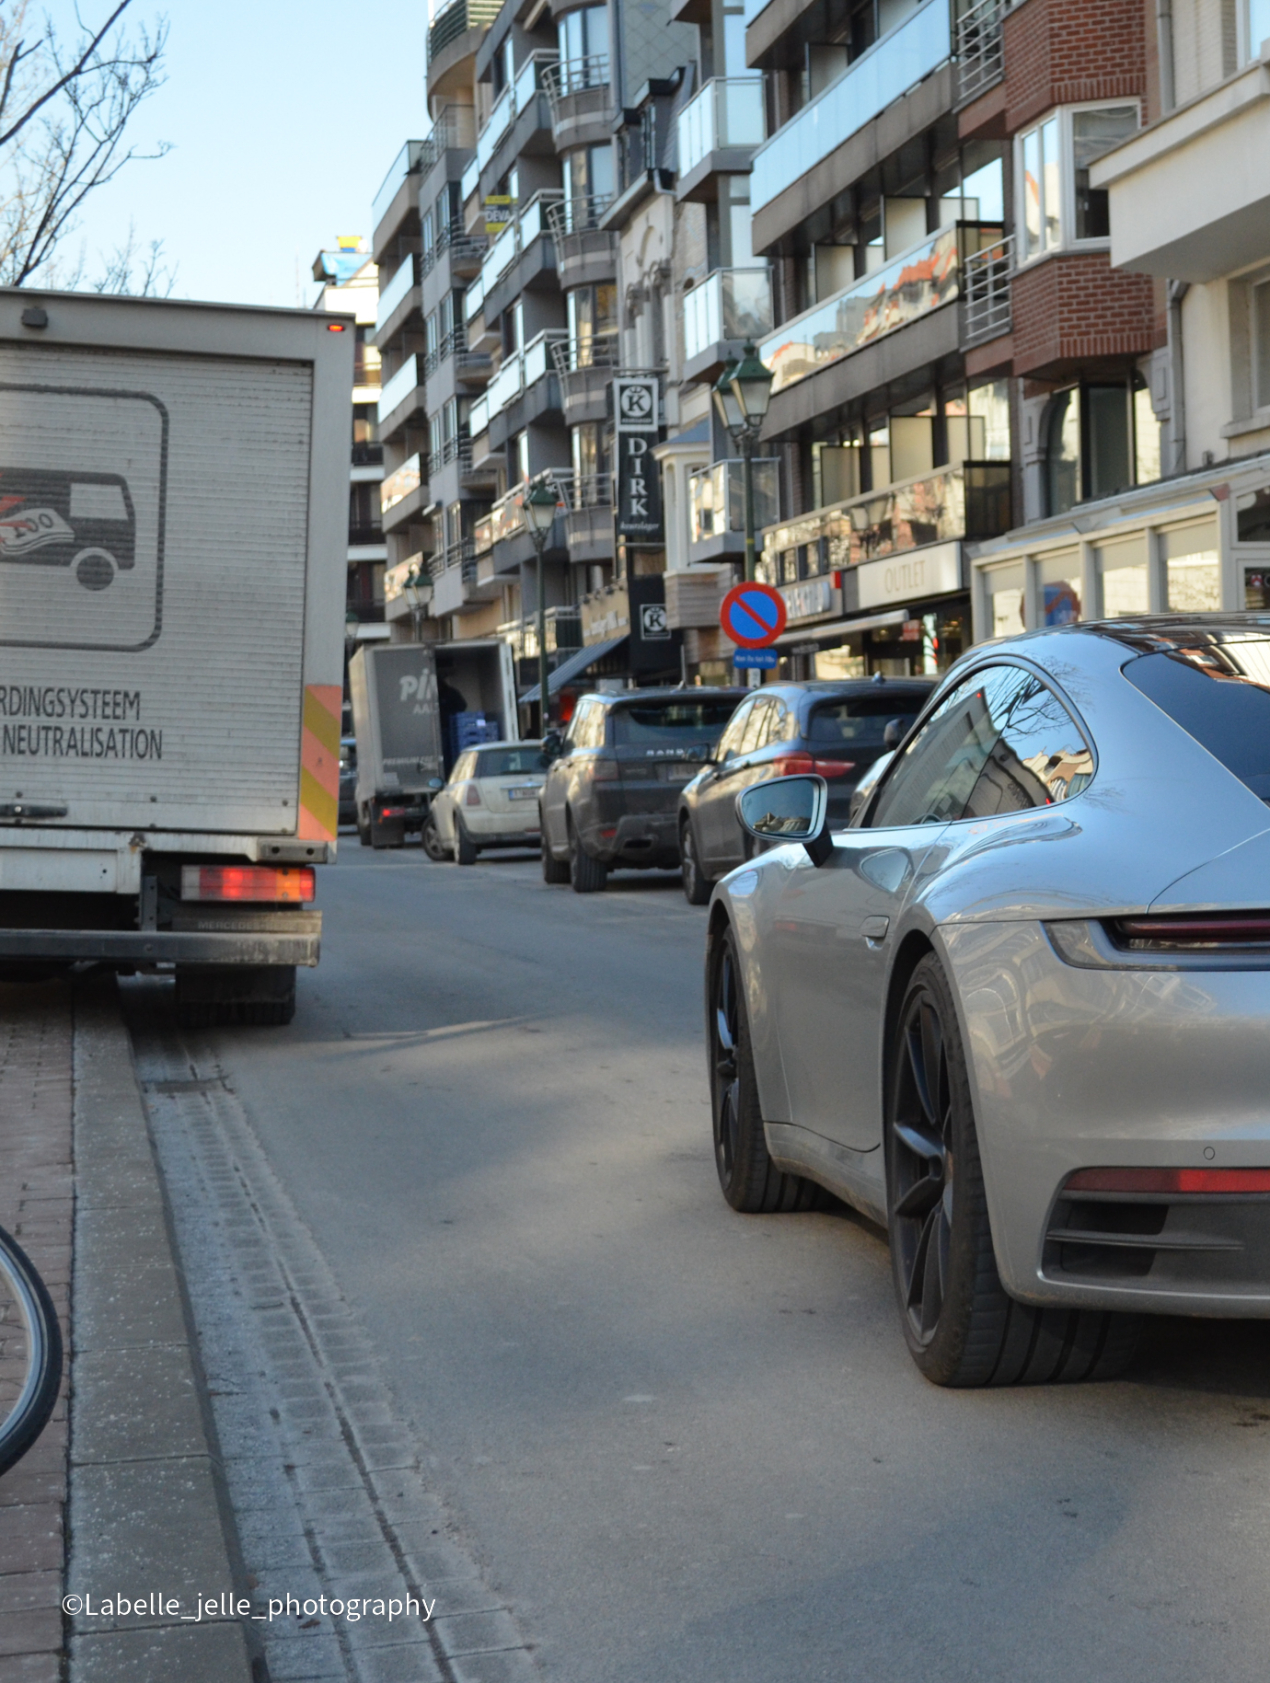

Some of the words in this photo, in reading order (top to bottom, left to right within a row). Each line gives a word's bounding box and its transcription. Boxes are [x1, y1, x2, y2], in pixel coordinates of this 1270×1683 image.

[626, 394, 645, 412] K
[627, 437, 648, 516] DIRK
[884, 560, 925, 594] OUTLET
[3, 724, 162, 760] NEUTRALISATION
